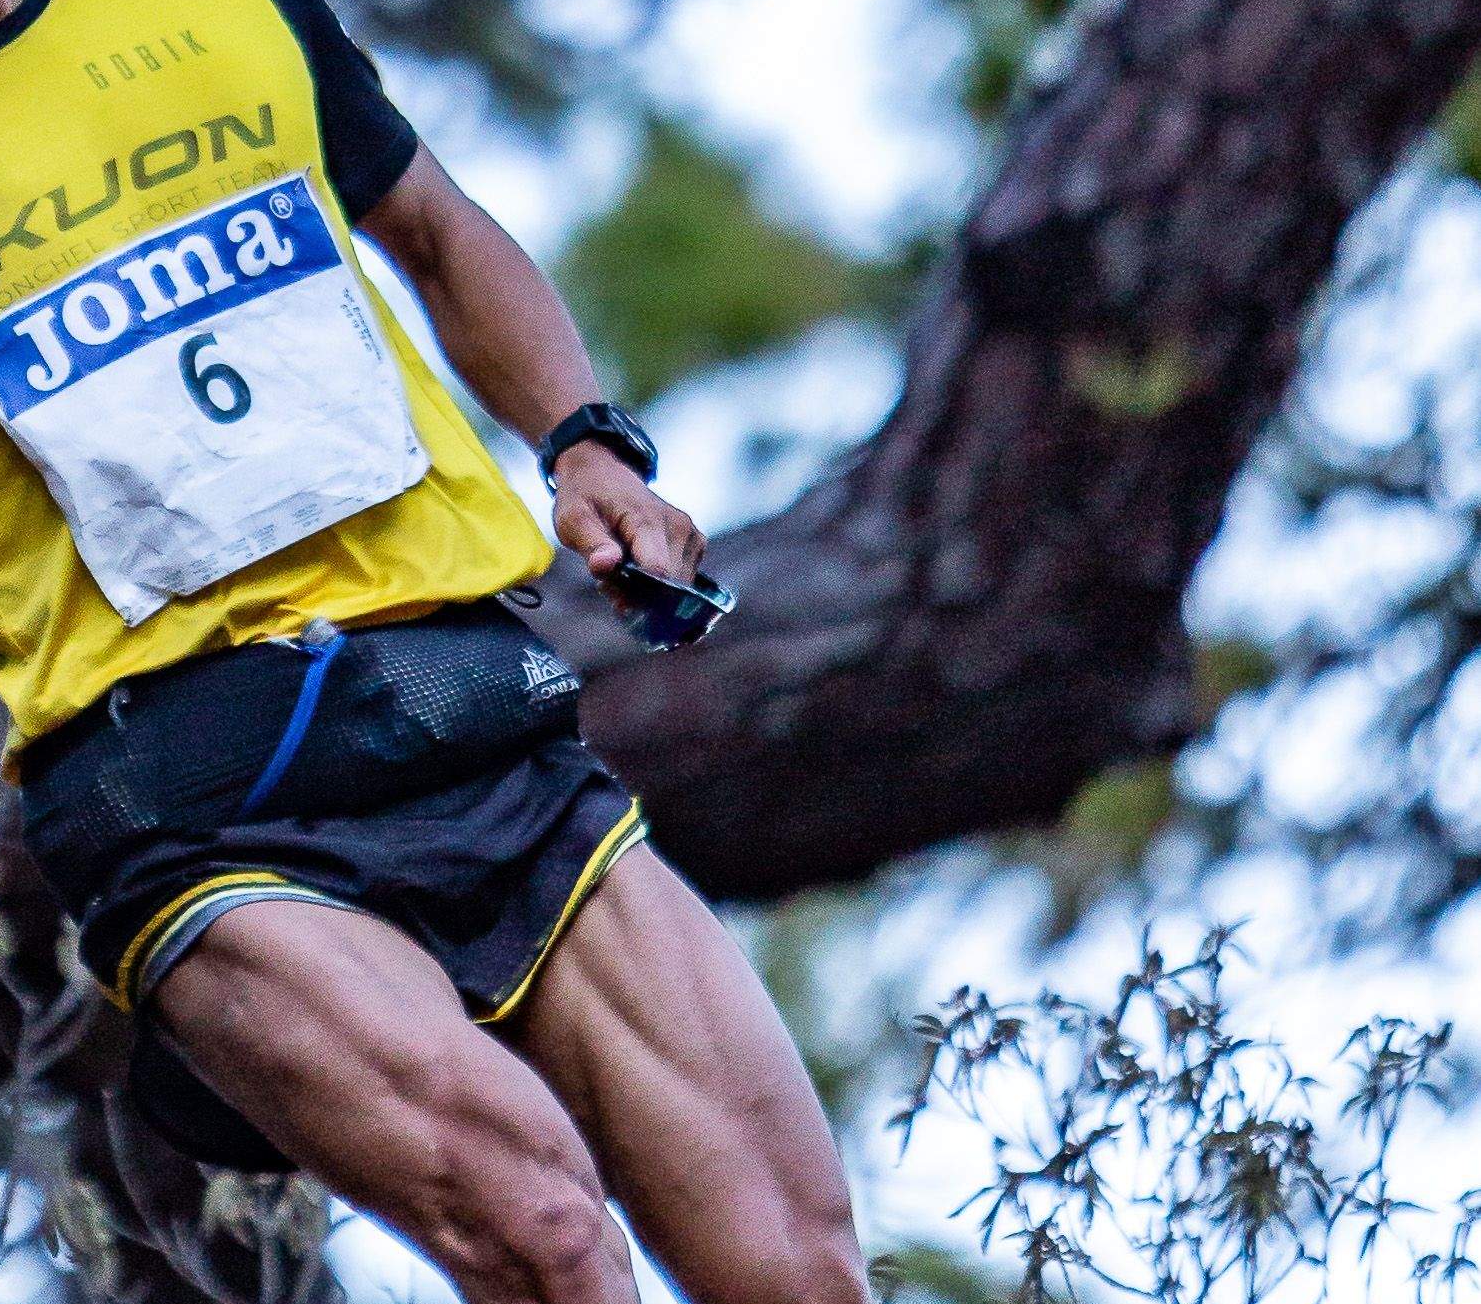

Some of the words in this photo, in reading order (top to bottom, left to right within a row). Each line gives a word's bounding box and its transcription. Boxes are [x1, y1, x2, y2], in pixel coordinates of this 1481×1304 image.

[84, 29, 208, 90] GOBIK
[112, 186, 200, 240] SPORT
[213, 160, 289, 195] TEAM
[177, 330, 253, 426] 6
